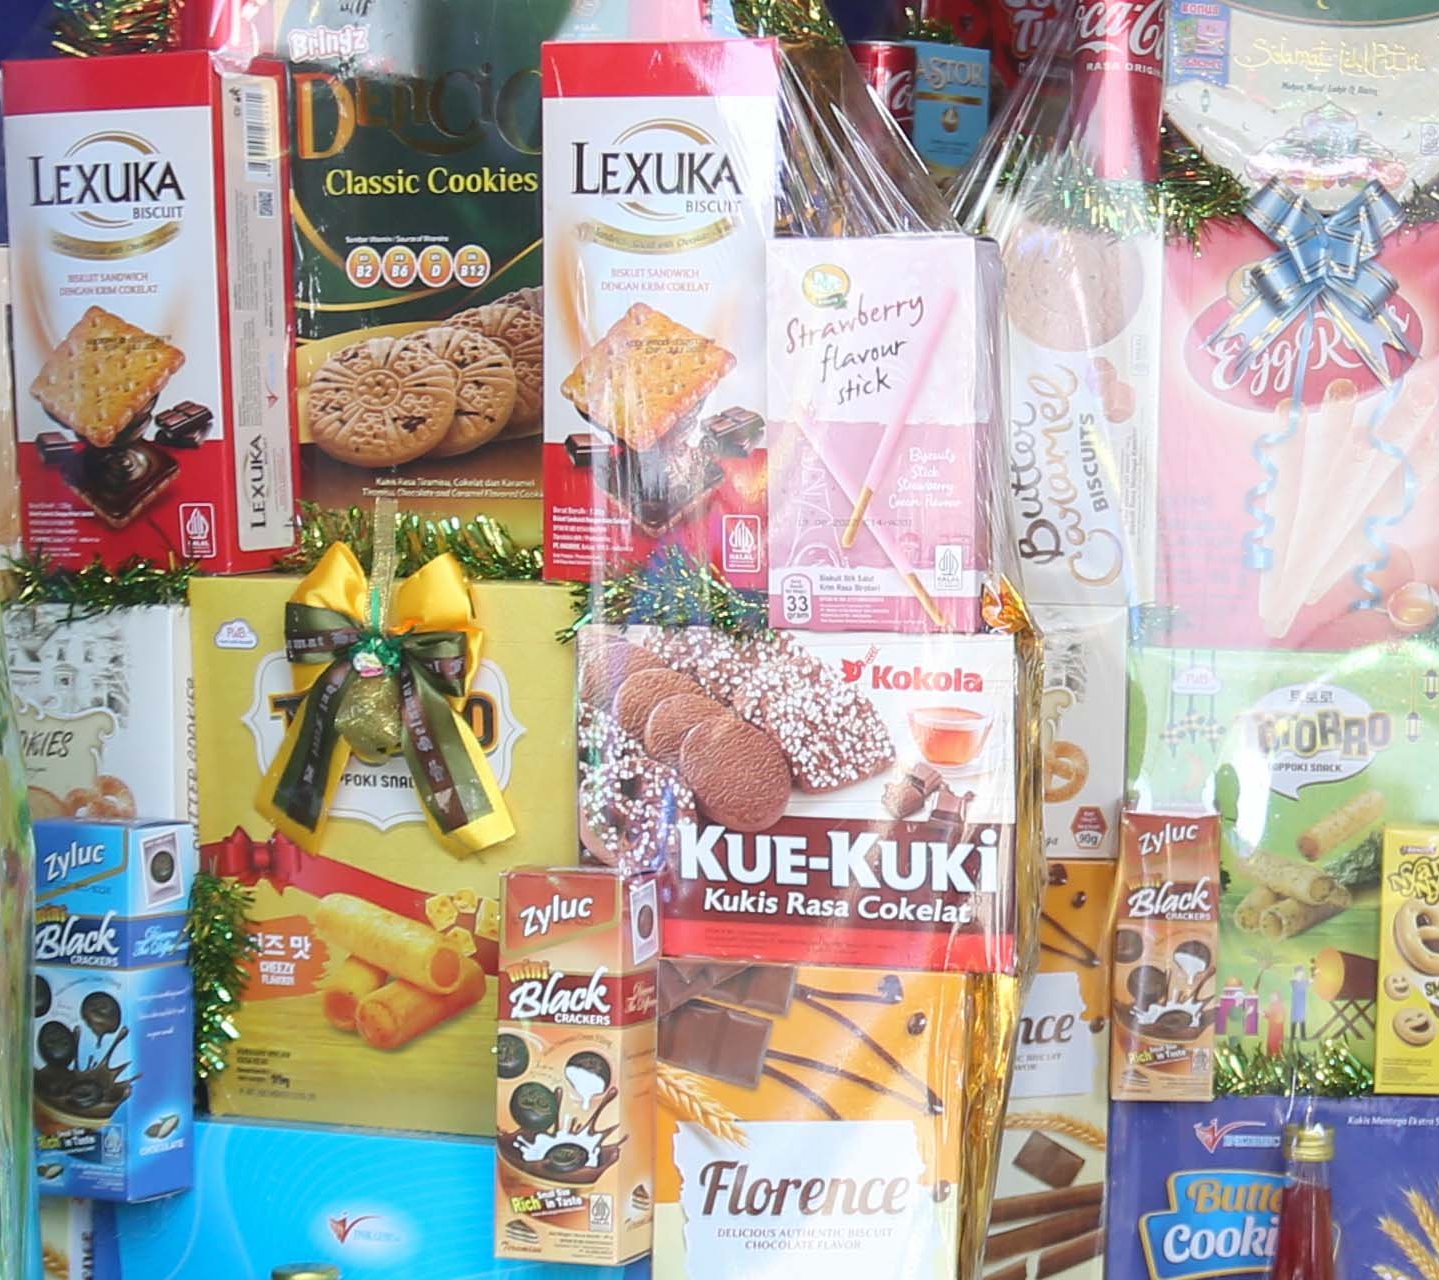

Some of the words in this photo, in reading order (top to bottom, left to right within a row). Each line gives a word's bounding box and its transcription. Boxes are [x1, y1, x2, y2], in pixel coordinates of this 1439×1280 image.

[28, 155, 186, 208] LEXUKA
[326, 169, 419, 197] Classic
[425, 167, 539, 196] Cookies
[571, 141, 743, 196] LEXUKA
[131, 204, 185, 220] BISCUIT
[685, 200, 742, 215] BISCUIT
[355, 265, 374, 279] B2
[391, 265, 409, 278] B6
[460, 265, 486, 278] B12
[786, 294, 925, 356] Strawberry
[820, 339, 907, 384] flavour
[837, 369, 892, 406] stick
[247, 433, 267, 529] LEXUKA
[1078, 412, 1110, 513] BISCUITS
[786, 595, 809, 613] 33
[871, 663, 984, 694] Kokola
[701, 887, 780, 918] Kukis
[786, 890, 850, 917] Rasa
[858, 893, 972, 926] Cokelat
[1128, 874, 1213, 920] Black
[34, 910, 120, 960] Black
[508, 964, 612, 1020] Black
[553, 1011, 612, 1027] CRACKERS
[512, 1195, 542, 1214] Rich
[698, 1160, 912, 1217] Florence
[716, 1226, 772, 1239] DELICIOUS
[775, 1226, 844, 1239] AUTHENTIC
[847, 1226, 894, 1240] BISCUIT
[744, 1238, 802, 1251] CHOCOLATE
[805, 1239, 862, 1251] FLAVOR
[1161, 1224, 1279, 1265] Cooki
